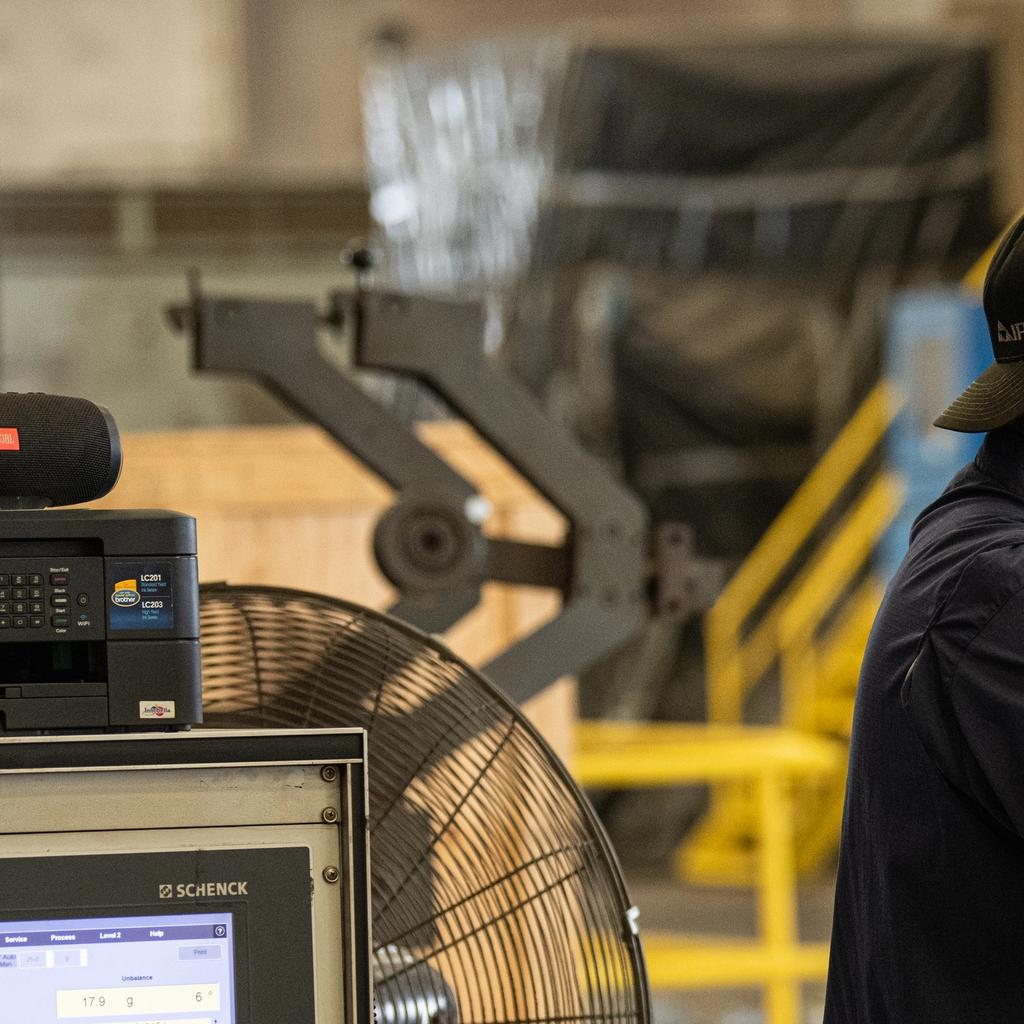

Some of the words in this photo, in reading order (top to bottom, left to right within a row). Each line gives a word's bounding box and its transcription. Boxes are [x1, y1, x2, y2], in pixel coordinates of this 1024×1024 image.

[140, 574, 161, 582] LC201
[141, 601, 164, 609] LC203
[176, 881, 249, 898] SCHENCK
[4, 936, 29, 944] Service
[50, 934, 77, 942] Process
[99, 932, 116, 940] Level
[149, 930, 165, 939] Help
[121, 974, 154, 982] Unbalance
[82, 996, 106, 1008] 17.9
[126, 996, 134, 1008] g
[195, 991, 203, 1003] 6
